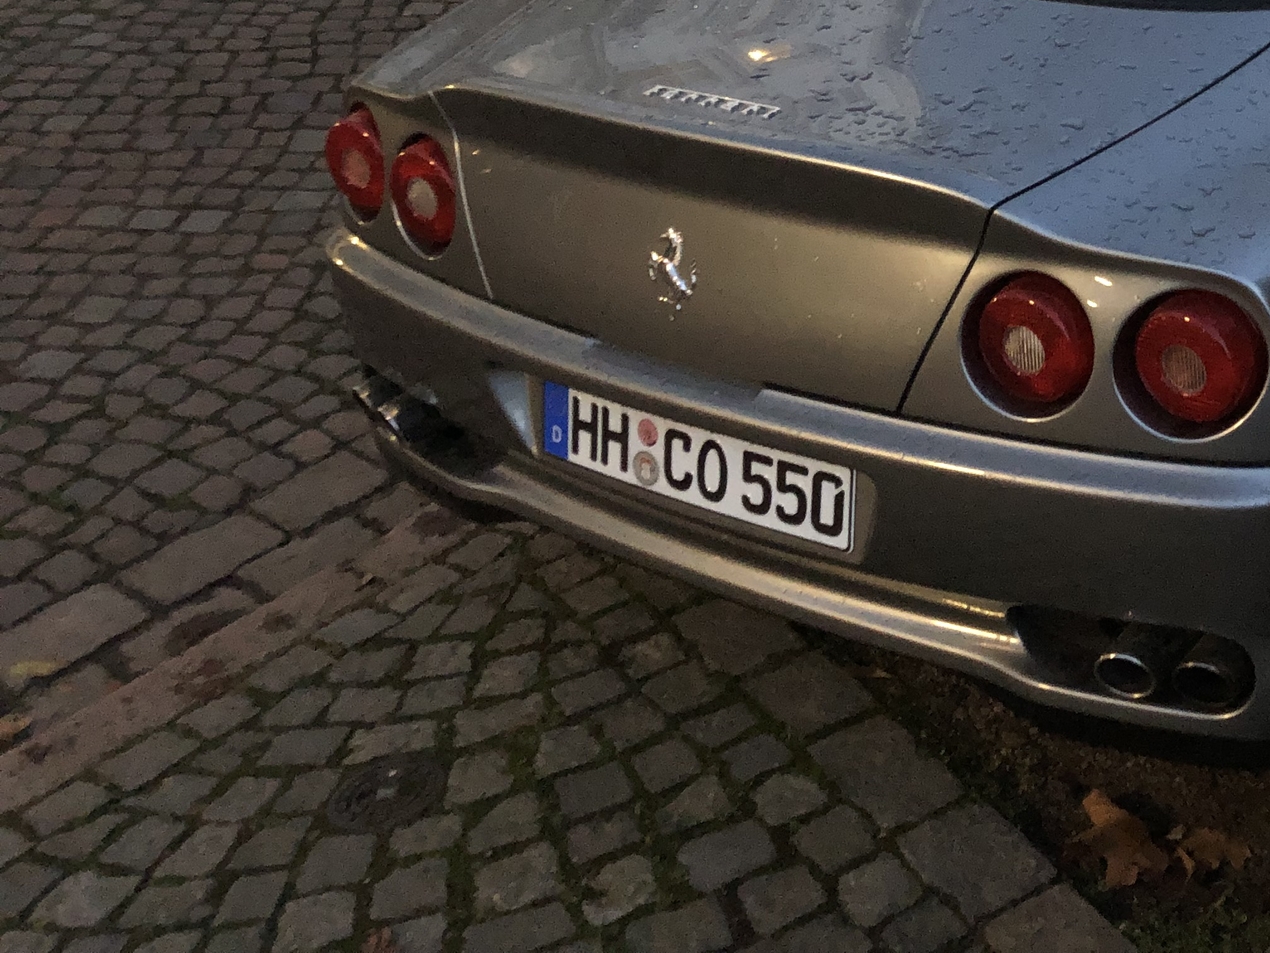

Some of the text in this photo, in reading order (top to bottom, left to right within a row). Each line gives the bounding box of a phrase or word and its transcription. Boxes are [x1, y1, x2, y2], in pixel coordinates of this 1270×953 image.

[552, 425, 562, 443] D
[571, 395, 846, 537] HH CO 550
